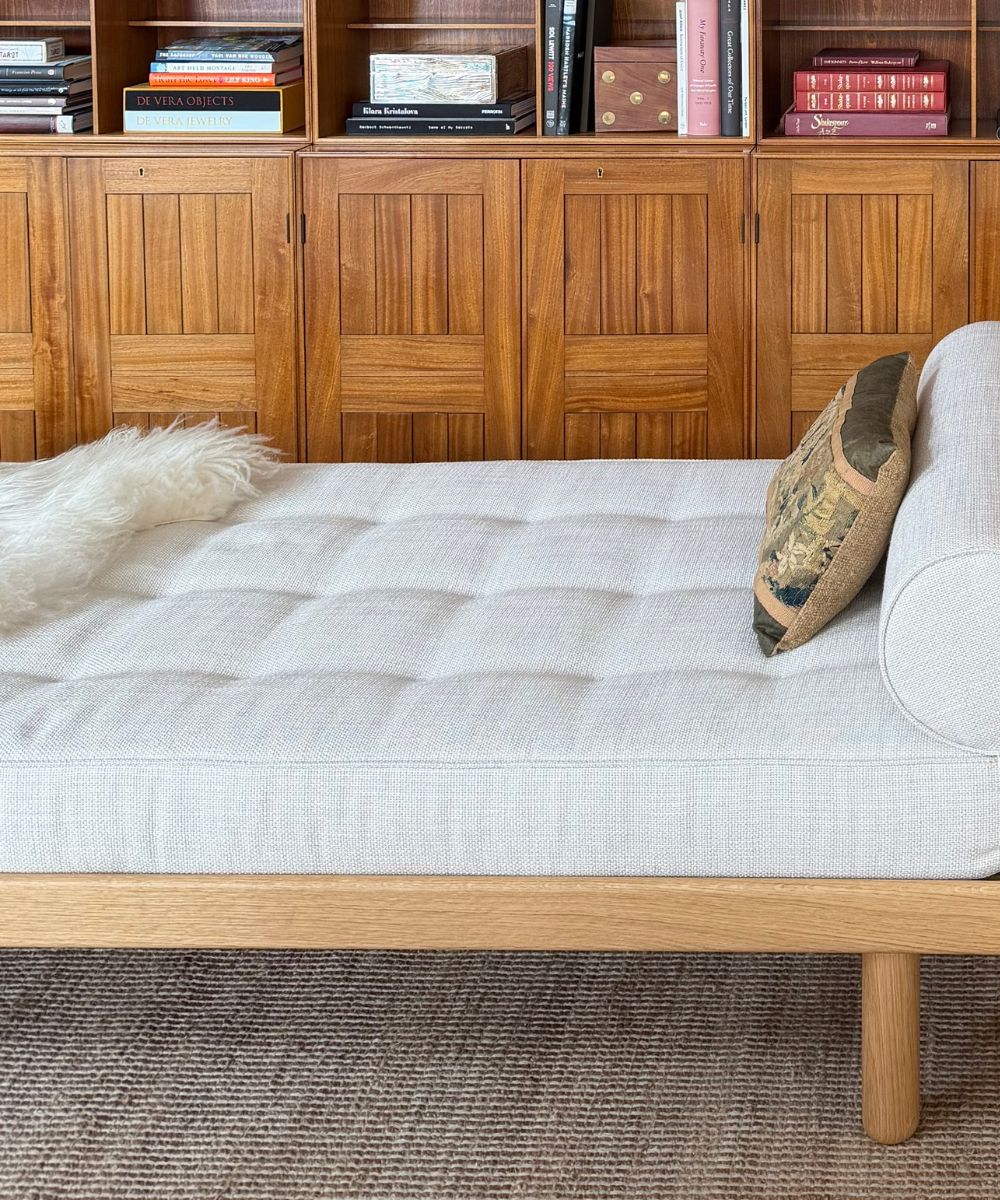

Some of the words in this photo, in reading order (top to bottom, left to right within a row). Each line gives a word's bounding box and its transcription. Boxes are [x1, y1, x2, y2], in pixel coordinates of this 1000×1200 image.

[136, 96, 150, 106] DE
[153, 96, 184, 106] VERA
[187, 96, 235, 106] OBJECTS
[363, 107, 381, 115] Klara
[384, 107, 418, 115] Kristalova
